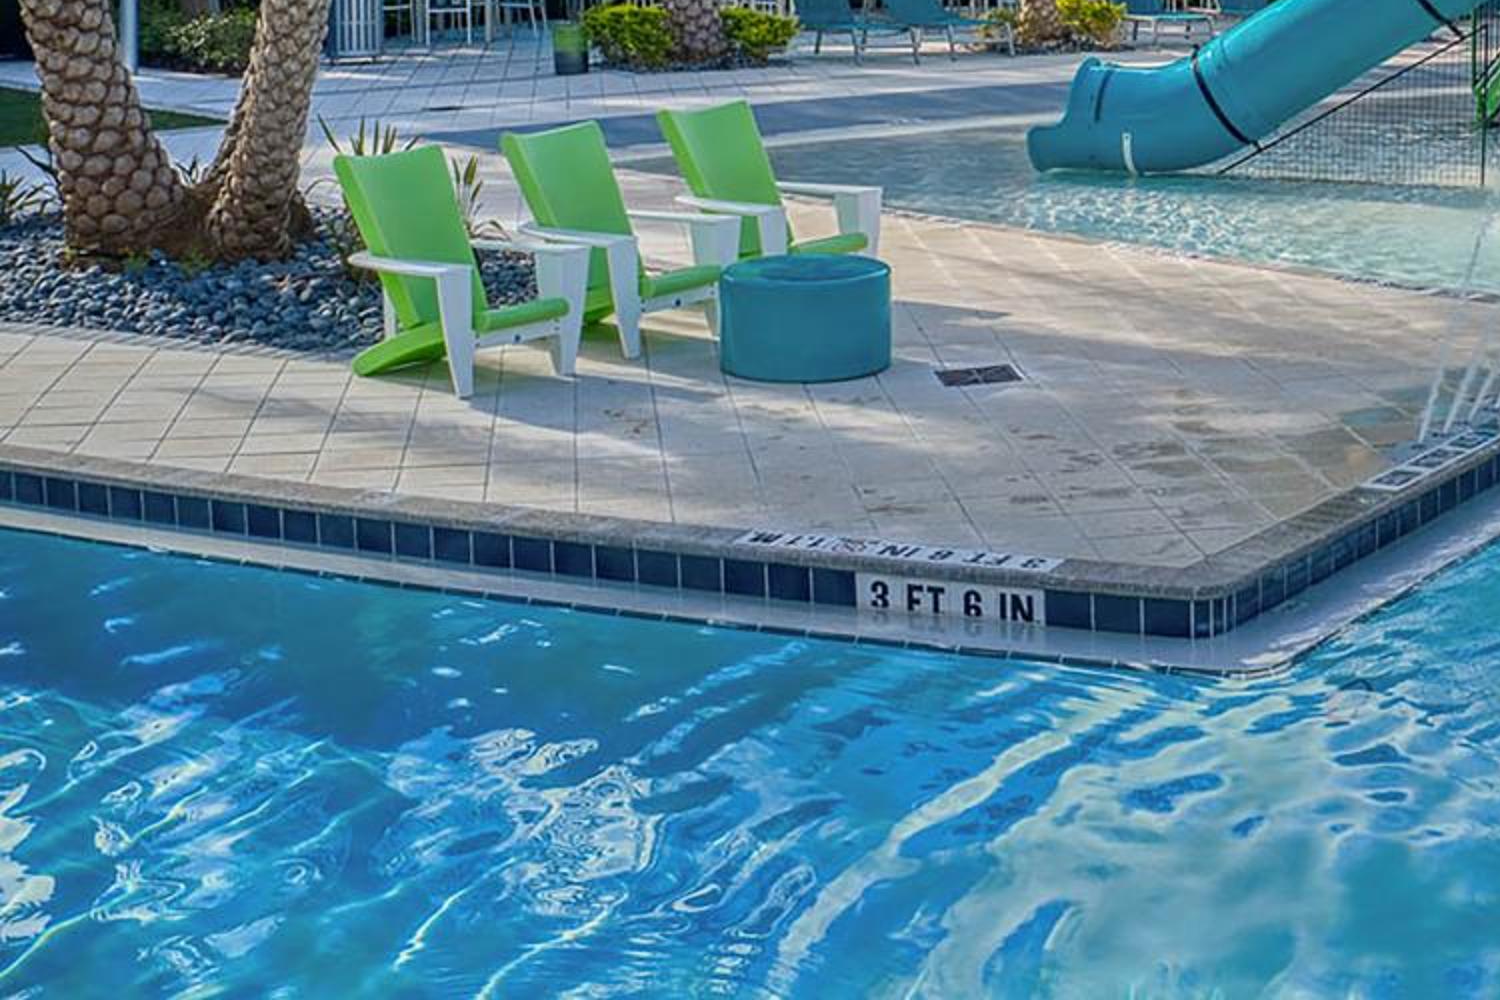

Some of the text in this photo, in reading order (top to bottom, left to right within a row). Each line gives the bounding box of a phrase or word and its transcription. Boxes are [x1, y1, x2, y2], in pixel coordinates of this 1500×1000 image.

[870, 580, 890, 609] 3
[906, 583, 945, 614] FT
[963, 589, 982, 618] 6
